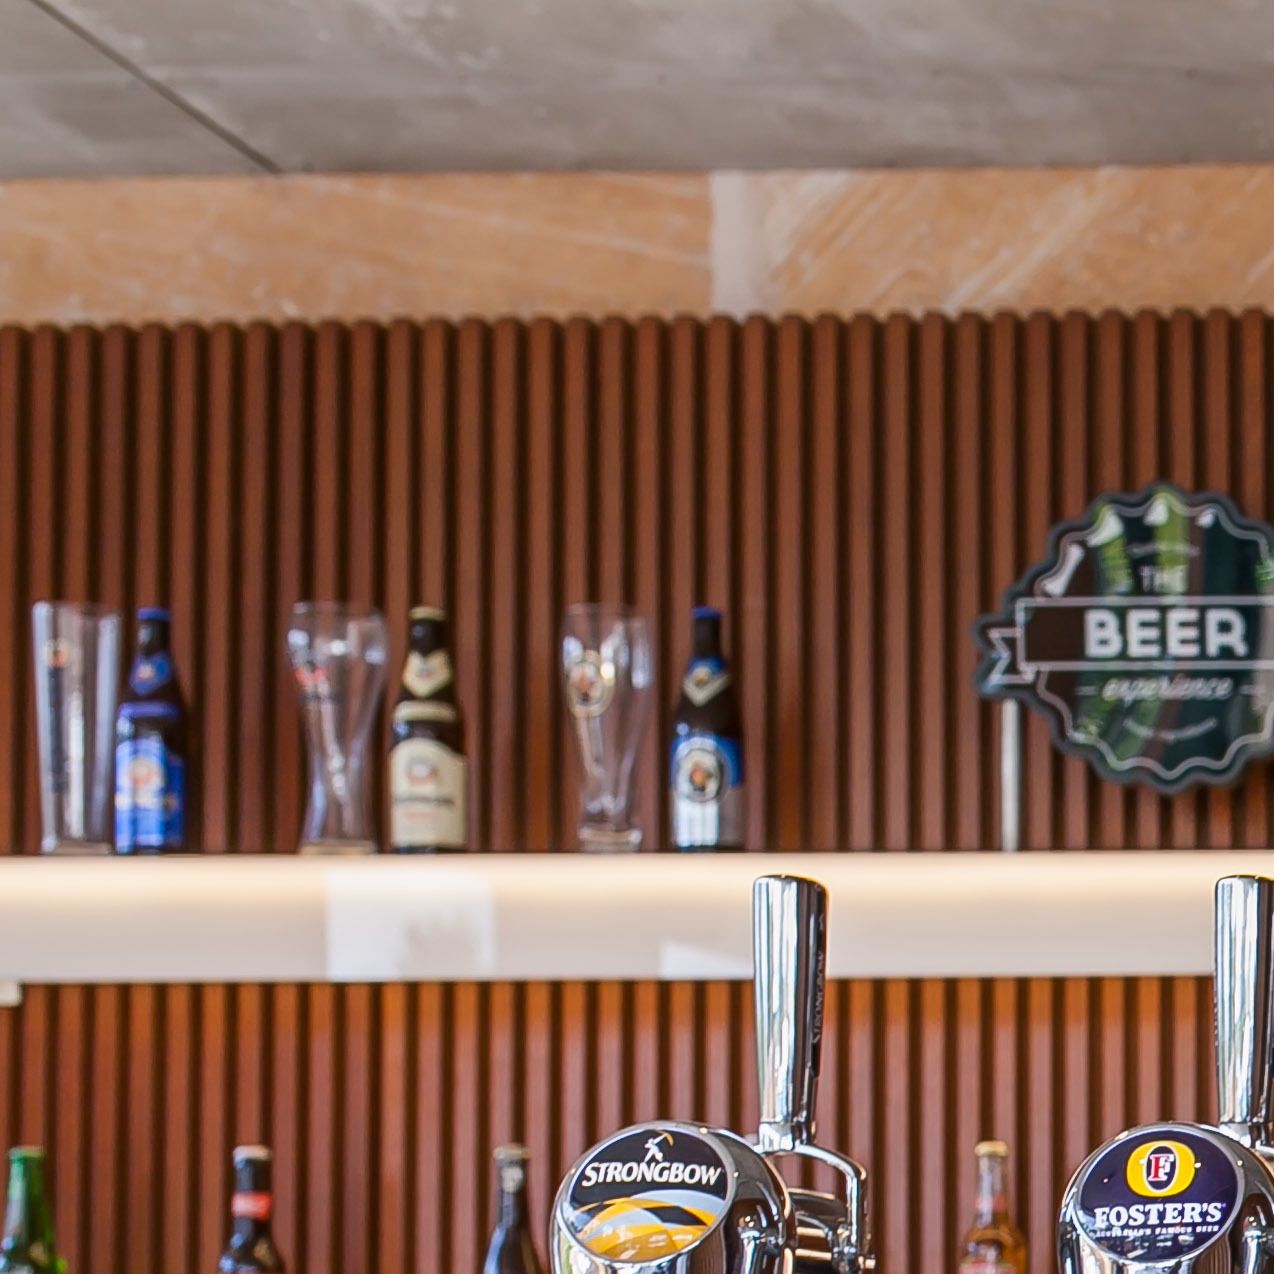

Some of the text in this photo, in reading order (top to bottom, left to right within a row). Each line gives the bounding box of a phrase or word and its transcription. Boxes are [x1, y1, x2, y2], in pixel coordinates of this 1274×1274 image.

[1083, 608, 1249, 658] BEER
[581, 1161, 723, 1187] STRONGBOW
[1094, 1203, 1223, 1228] FOSTER'S
